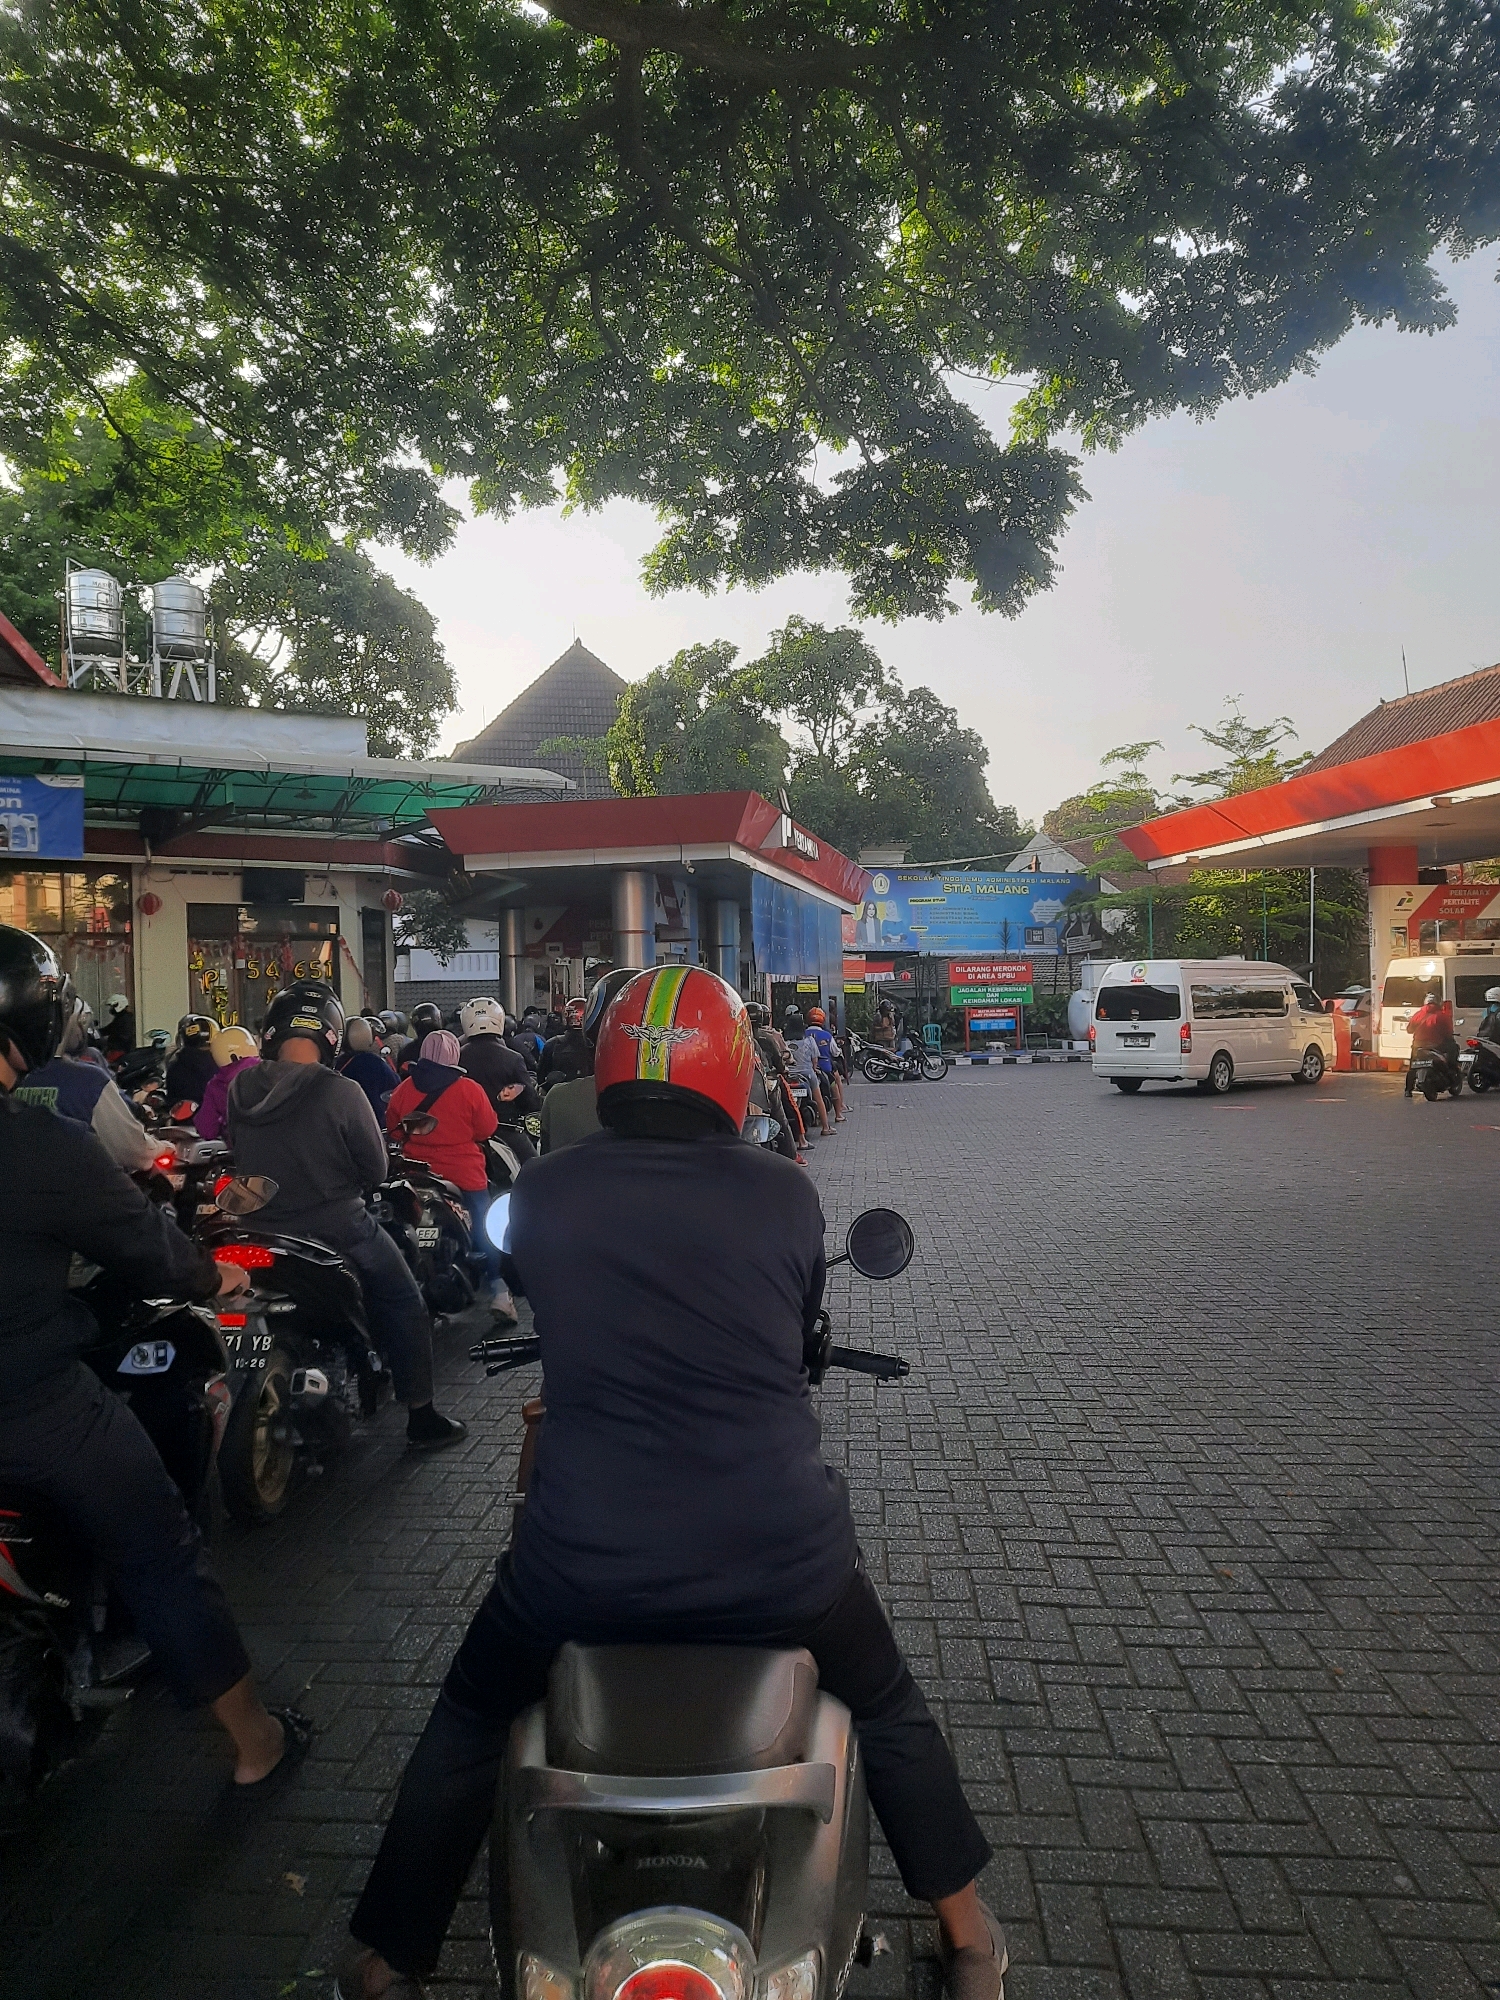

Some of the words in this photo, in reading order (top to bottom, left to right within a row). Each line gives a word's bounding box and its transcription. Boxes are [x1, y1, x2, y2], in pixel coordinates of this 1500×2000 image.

[943, 884, 973, 894] STIA
[976, 884, 1030, 895] MALANG
[1443, 898, 1480, 906] PERTALITE
[1438, 907, 1466, 915] SOLAR
[222, 1334, 243, 1352] 71
[252, 1334, 272, 1351] YB
[636, 1854, 709, 1870] HONDA
